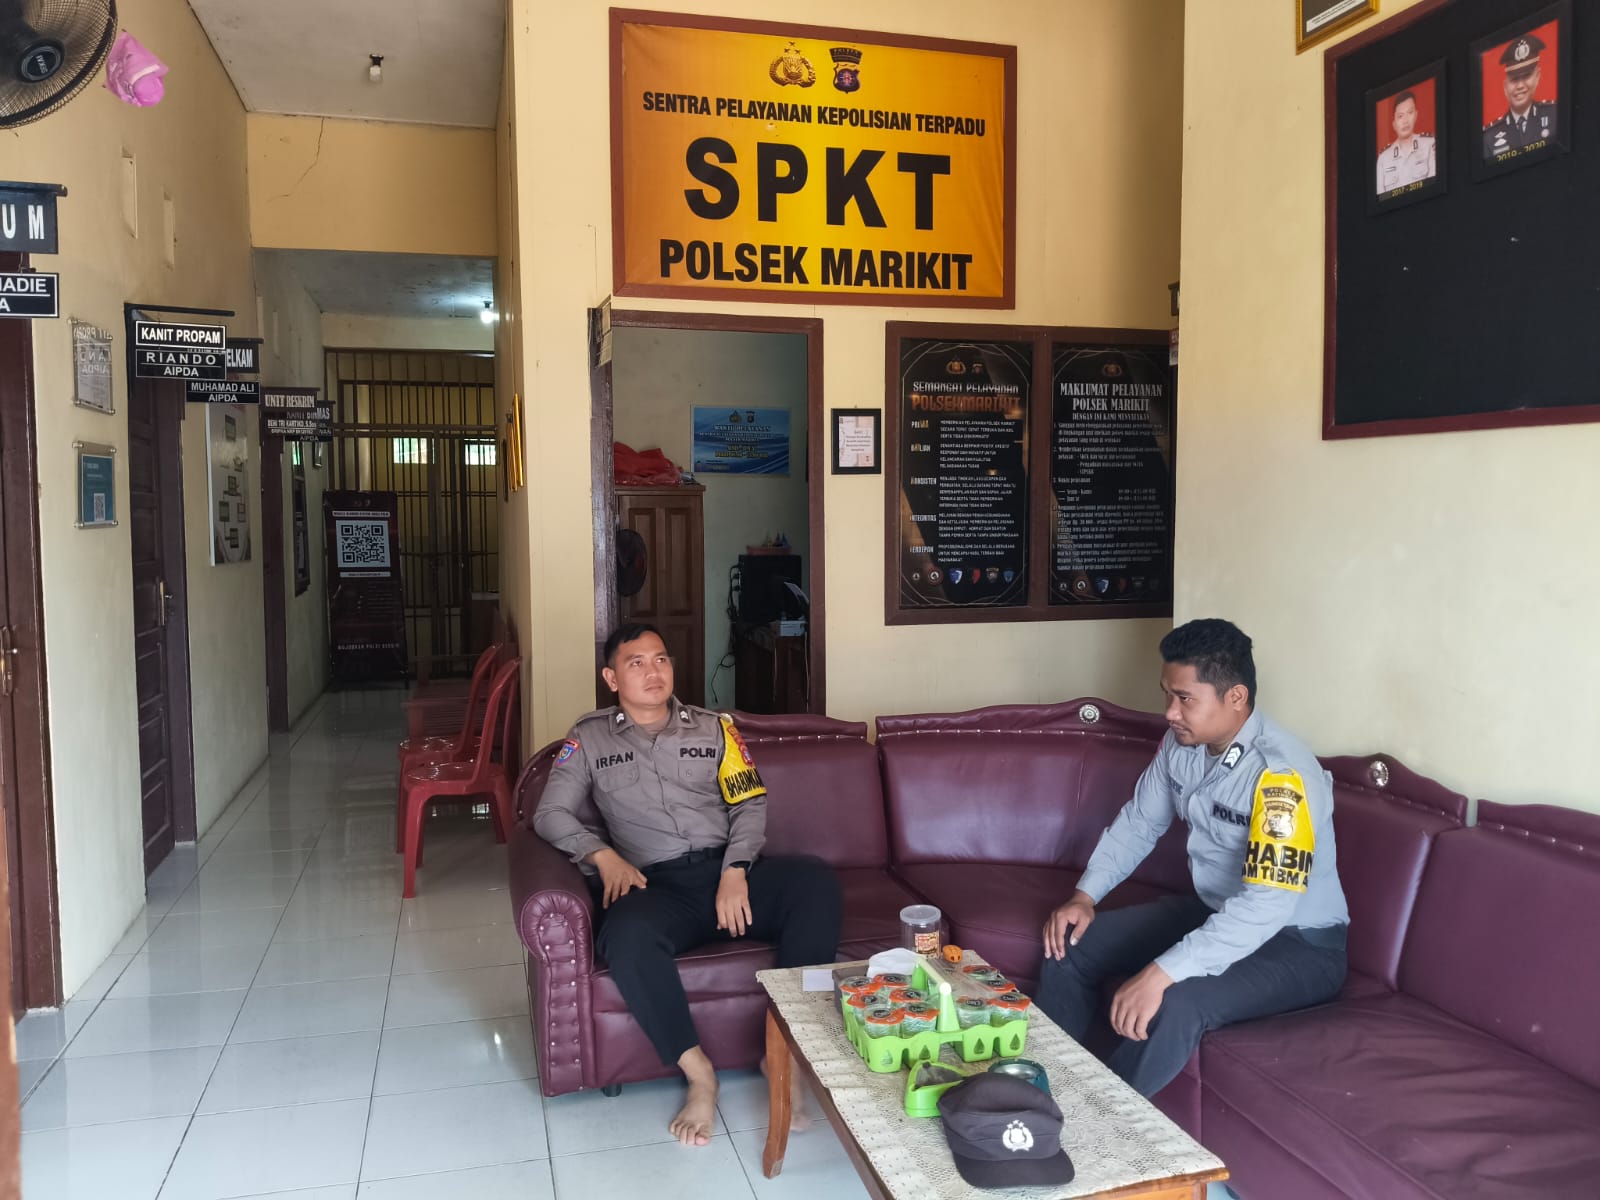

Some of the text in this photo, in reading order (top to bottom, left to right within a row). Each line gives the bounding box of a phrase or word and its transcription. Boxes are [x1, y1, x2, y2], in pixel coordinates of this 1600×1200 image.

[643, 91, 986, 136] SENTRA PELAYANAN KEPOLISIAN TERPADU
[684, 136, 950, 230] SPKT
[660, 238, 972, 290] POLSEK MARIKIT
[142, 327, 220, 344] KANIT PROPAM
[146, 352, 216, 365] RIANDO
[164, 366, 199, 377] AIPDA
[191, 382, 254, 392] MUHAMAD ALI
[913, 382, 1018, 394] SEMANGAT PELAYANAN
[1060, 382, 1162, 396] MAKLUMAT PELAYANAN
[208, 394, 238, 402] AIPDA
[265, 394, 314, 408] UNIT RESKRIM
[1072, 398, 1150, 411] POLSEK MARIKIT
[679, 747, 716, 759] POLRI
[596, 751, 634, 770] IRFAN
